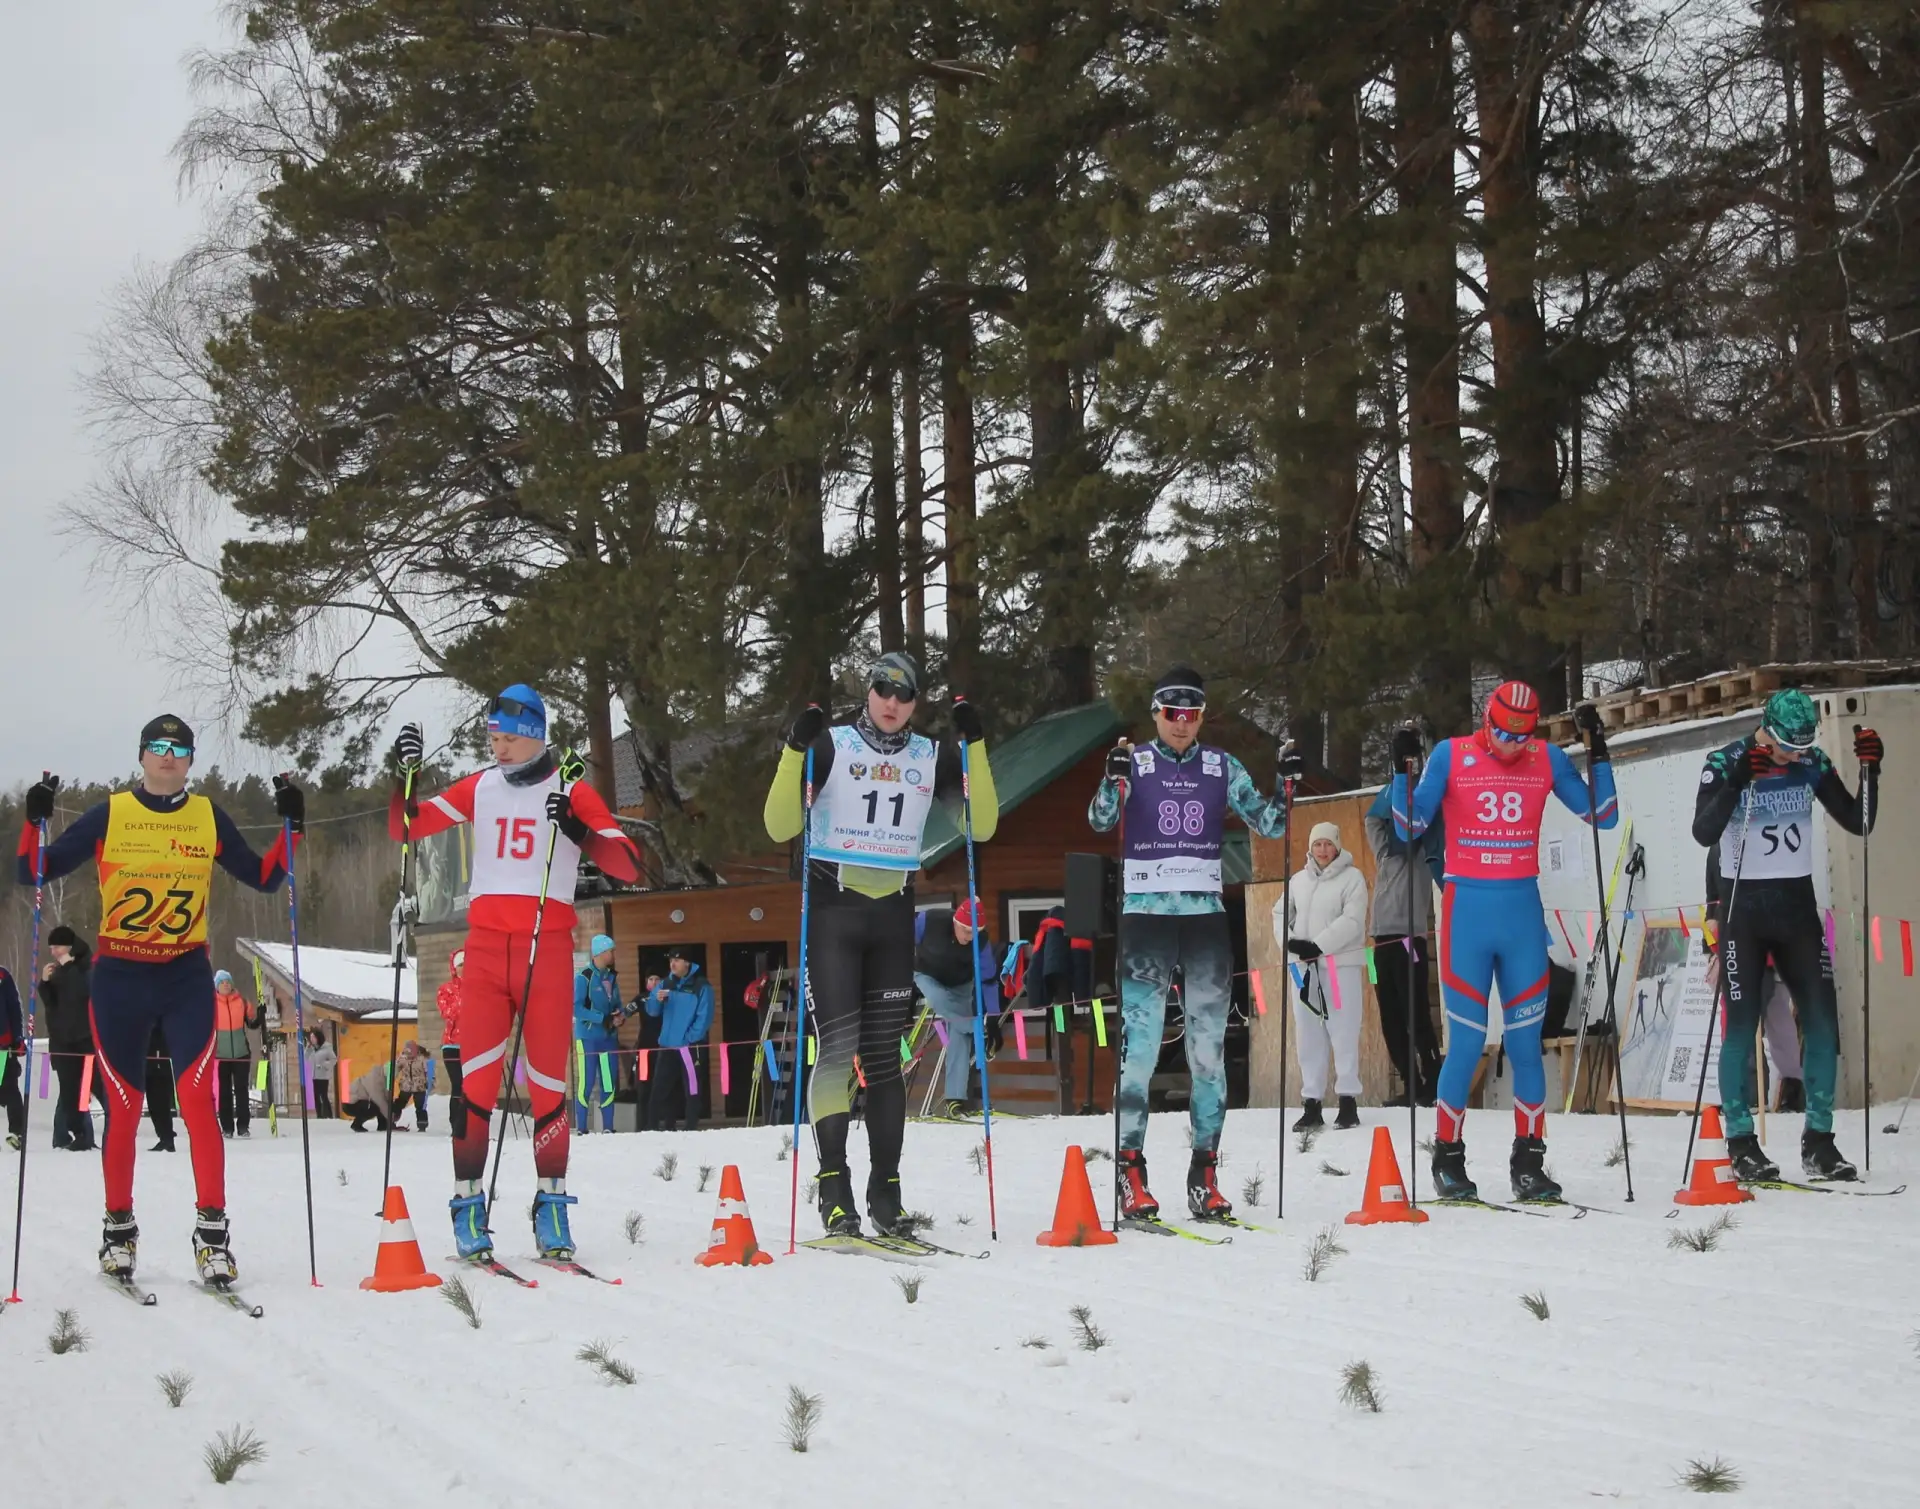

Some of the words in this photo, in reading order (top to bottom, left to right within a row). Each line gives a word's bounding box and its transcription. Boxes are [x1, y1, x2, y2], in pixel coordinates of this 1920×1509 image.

[1162, 781, 1173, 790] Тур
[1183, 781, 1199, 789] Бург
[862, 790, 905, 827] 11
[1158, 800, 1205, 836] 88
[1476, 791, 1523, 823] 38
[124, 822, 199, 833] ЕКАТЕРИНБУРГ
[496, 817, 537, 860] 15
[834, 827, 870, 838] ЛЫЖНЯ
[1761, 823, 1802, 856] 50
[1153, 841, 1177, 849] Главы
[119, 887, 194, 936] 23
[1726, 940, 1742, 1001] PROLAB
[884, 990, 912, 999] CRAFT
